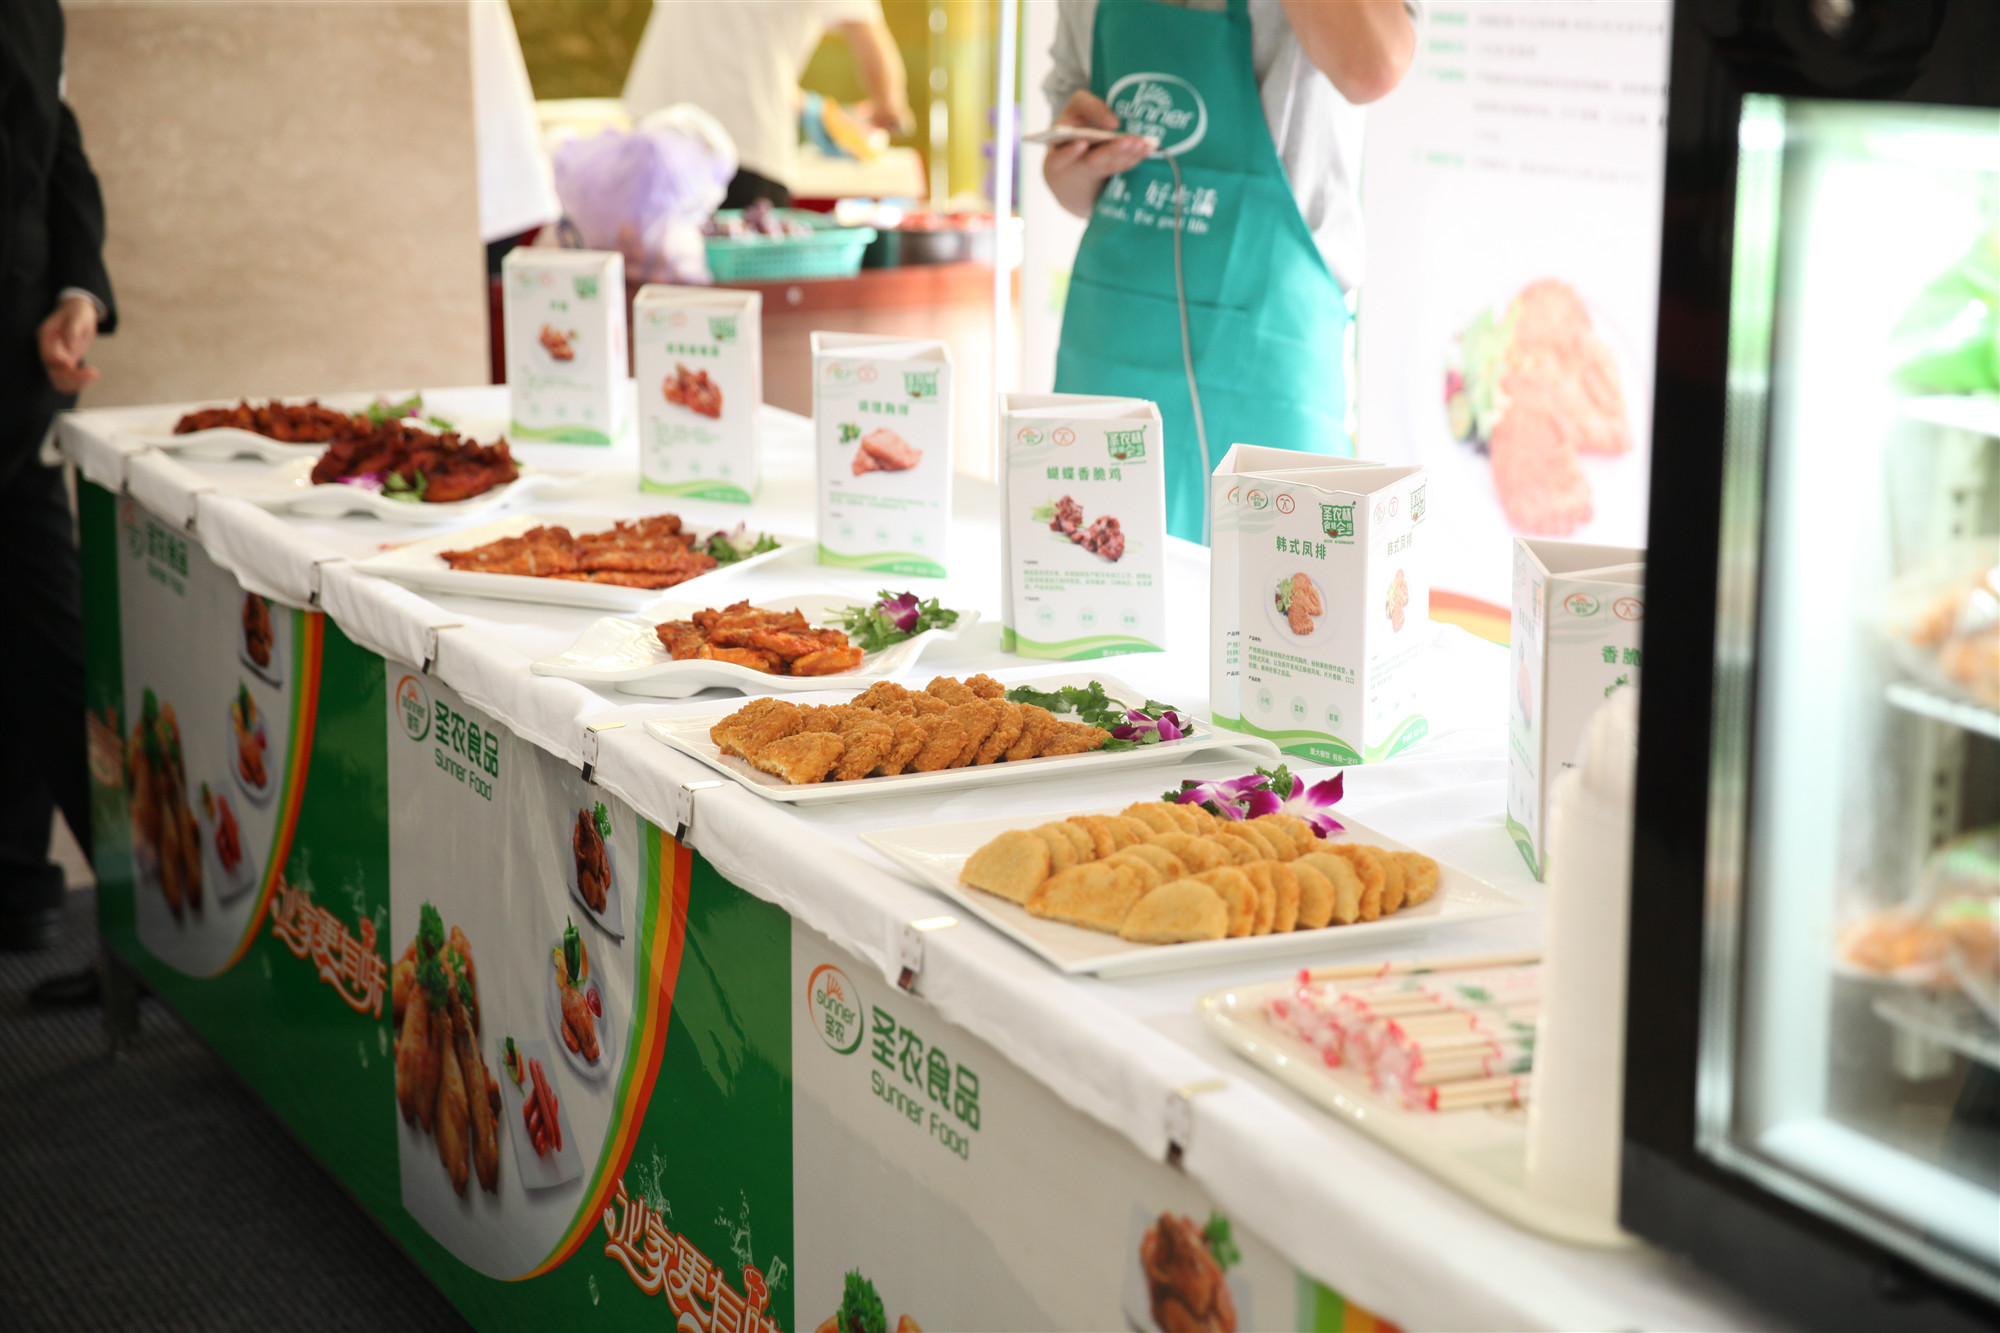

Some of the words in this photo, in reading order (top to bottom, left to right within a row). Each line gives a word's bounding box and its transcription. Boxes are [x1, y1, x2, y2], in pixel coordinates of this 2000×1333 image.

[1046, 465, 1122, 482] 蝴蝶香脆鸡
[1276, 535, 1327, 560] 韩式凤排
[435, 699, 499, 778] 圣农食品
[435, 747, 467, 783] Sunner
[469, 771, 492, 802] Food
[825, 1012, 845, 1045] 圣农
[872, 1004, 980, 1131] 圣农食品
[871, 1069, 924, 1126] Sunner
[929, 1112, 969, 1161] Food
